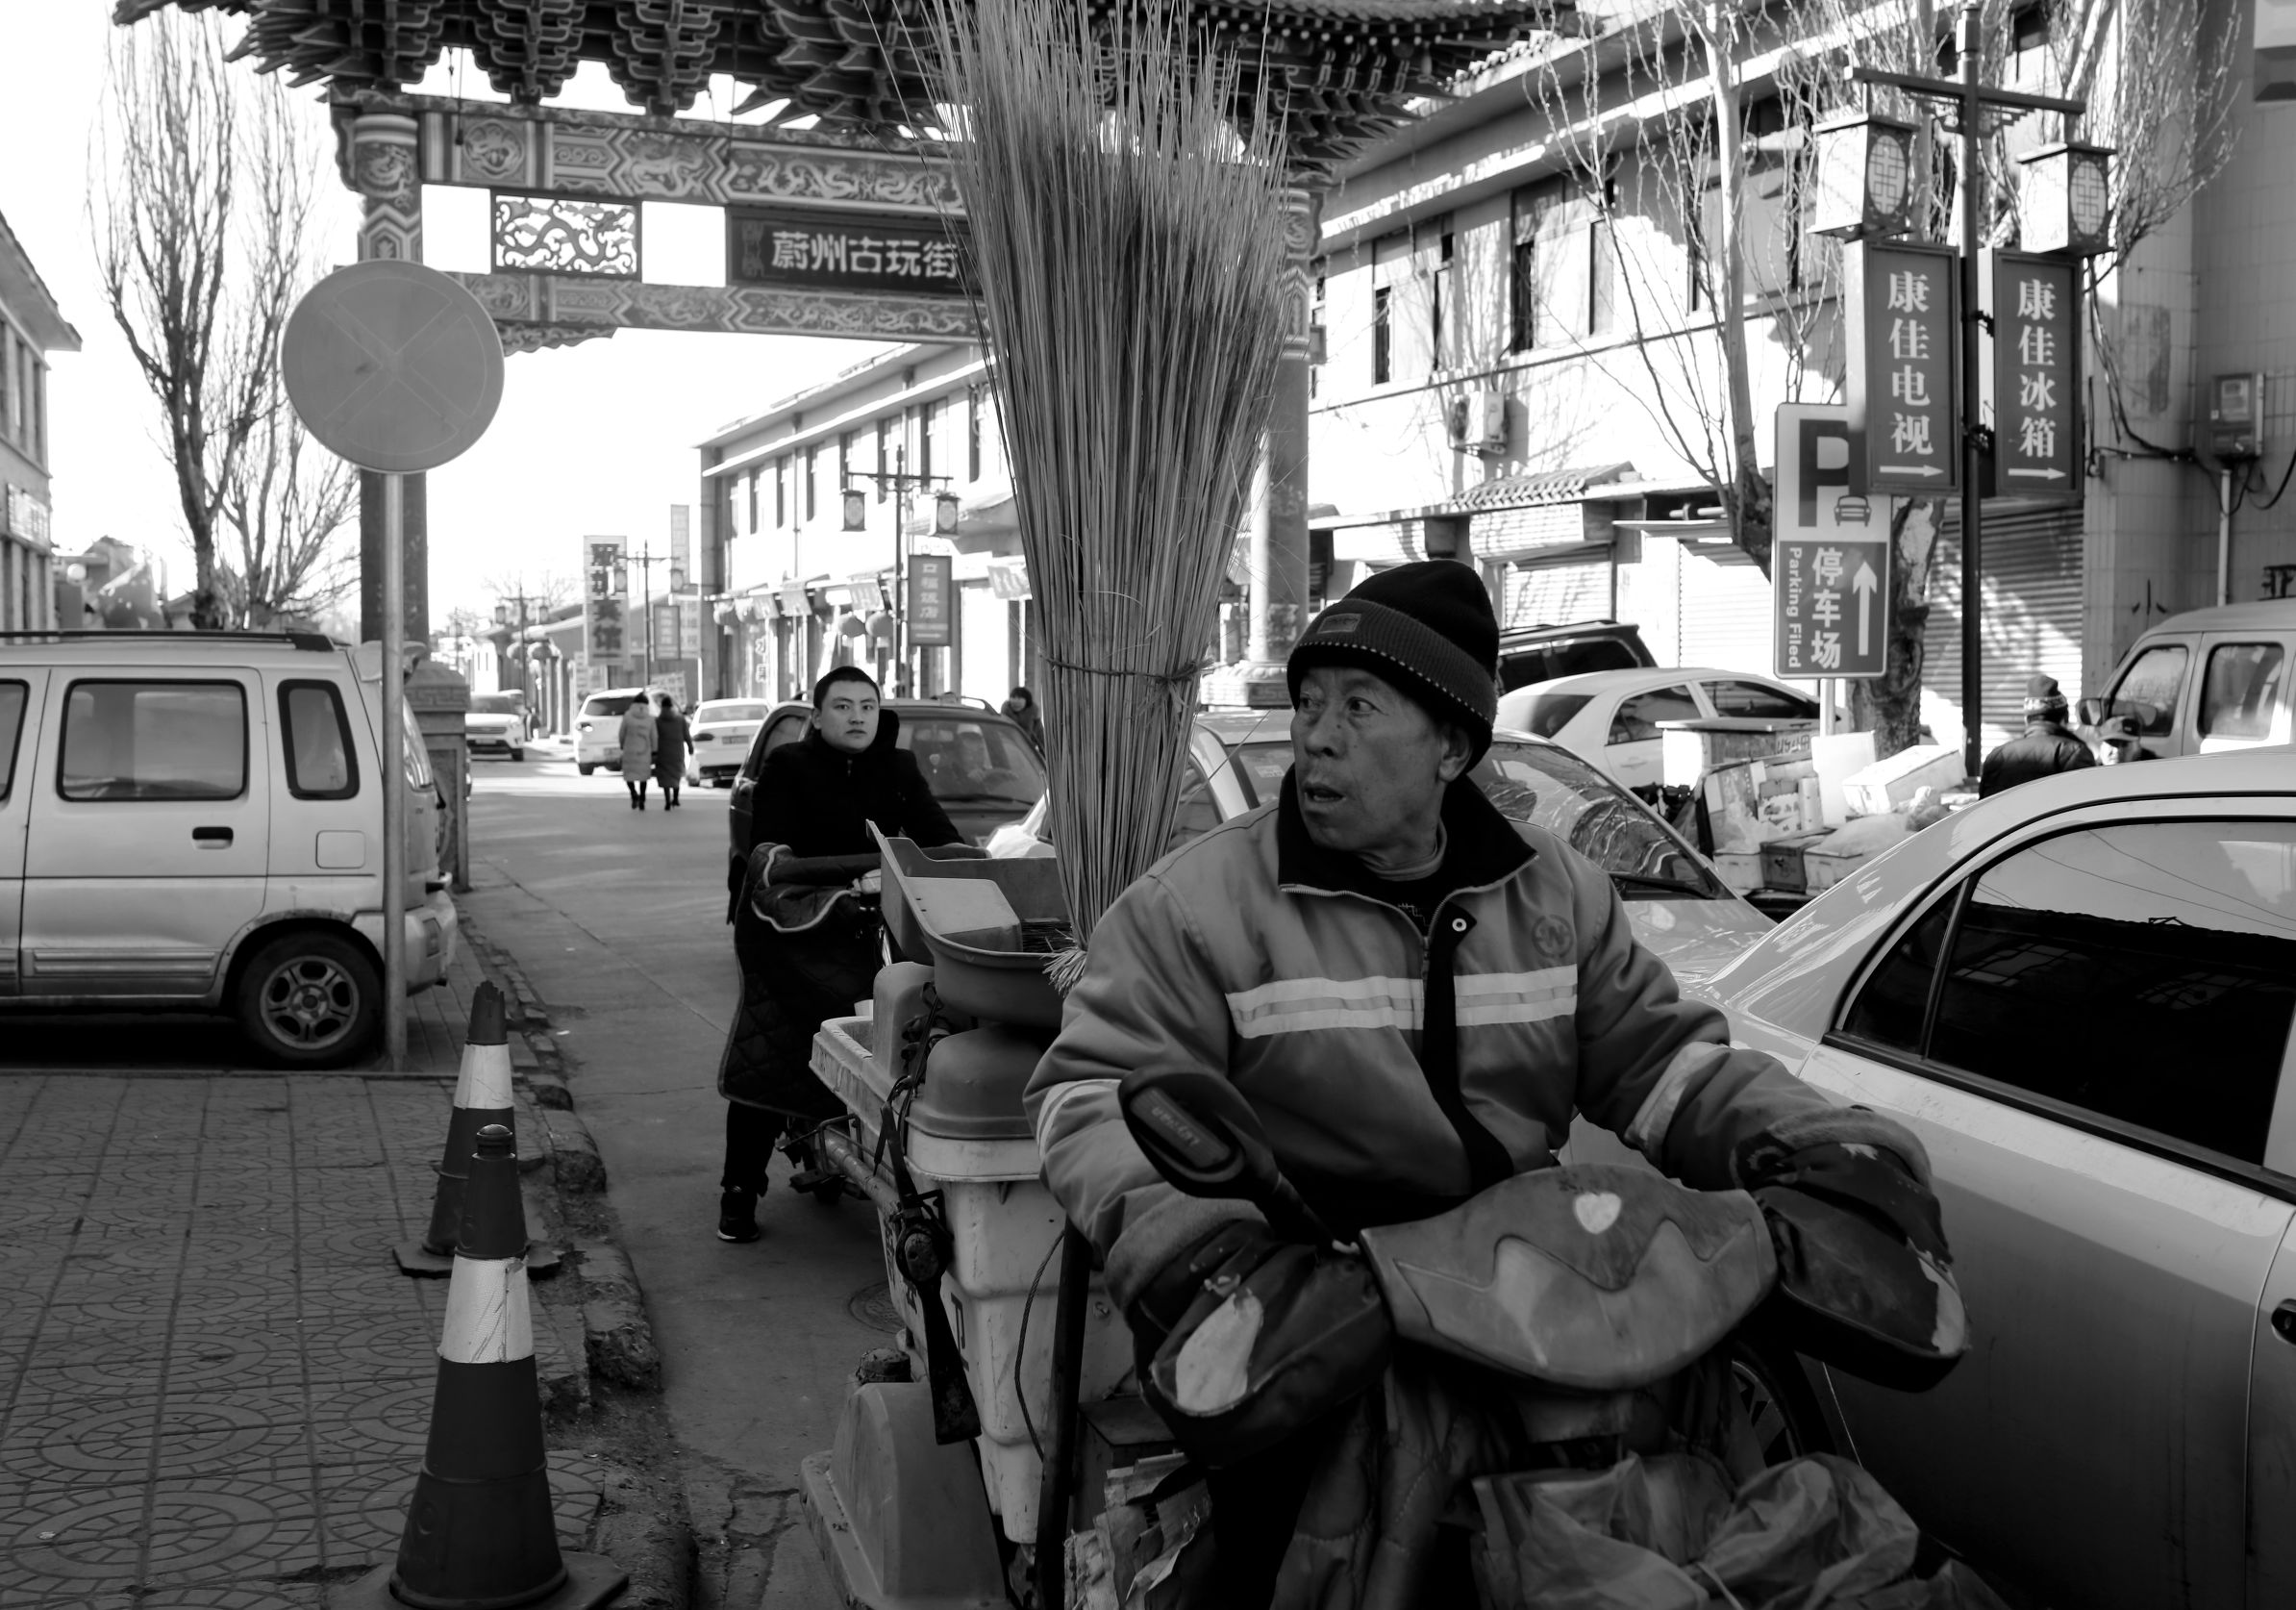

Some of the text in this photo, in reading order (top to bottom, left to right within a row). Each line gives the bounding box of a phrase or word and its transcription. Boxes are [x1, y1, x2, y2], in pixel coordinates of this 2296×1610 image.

[771, 231, 958, 278] 蔚州古玩街
[1887, 271, 1934, 456] 康佳电视
[2017, 279, 2058, 459] 康佳冰箱
[1799, 418, 1851, 527] P
[1786, 546, 1803, 667] Parking Filed
[1810, 546, 1843, 670] 停车场
